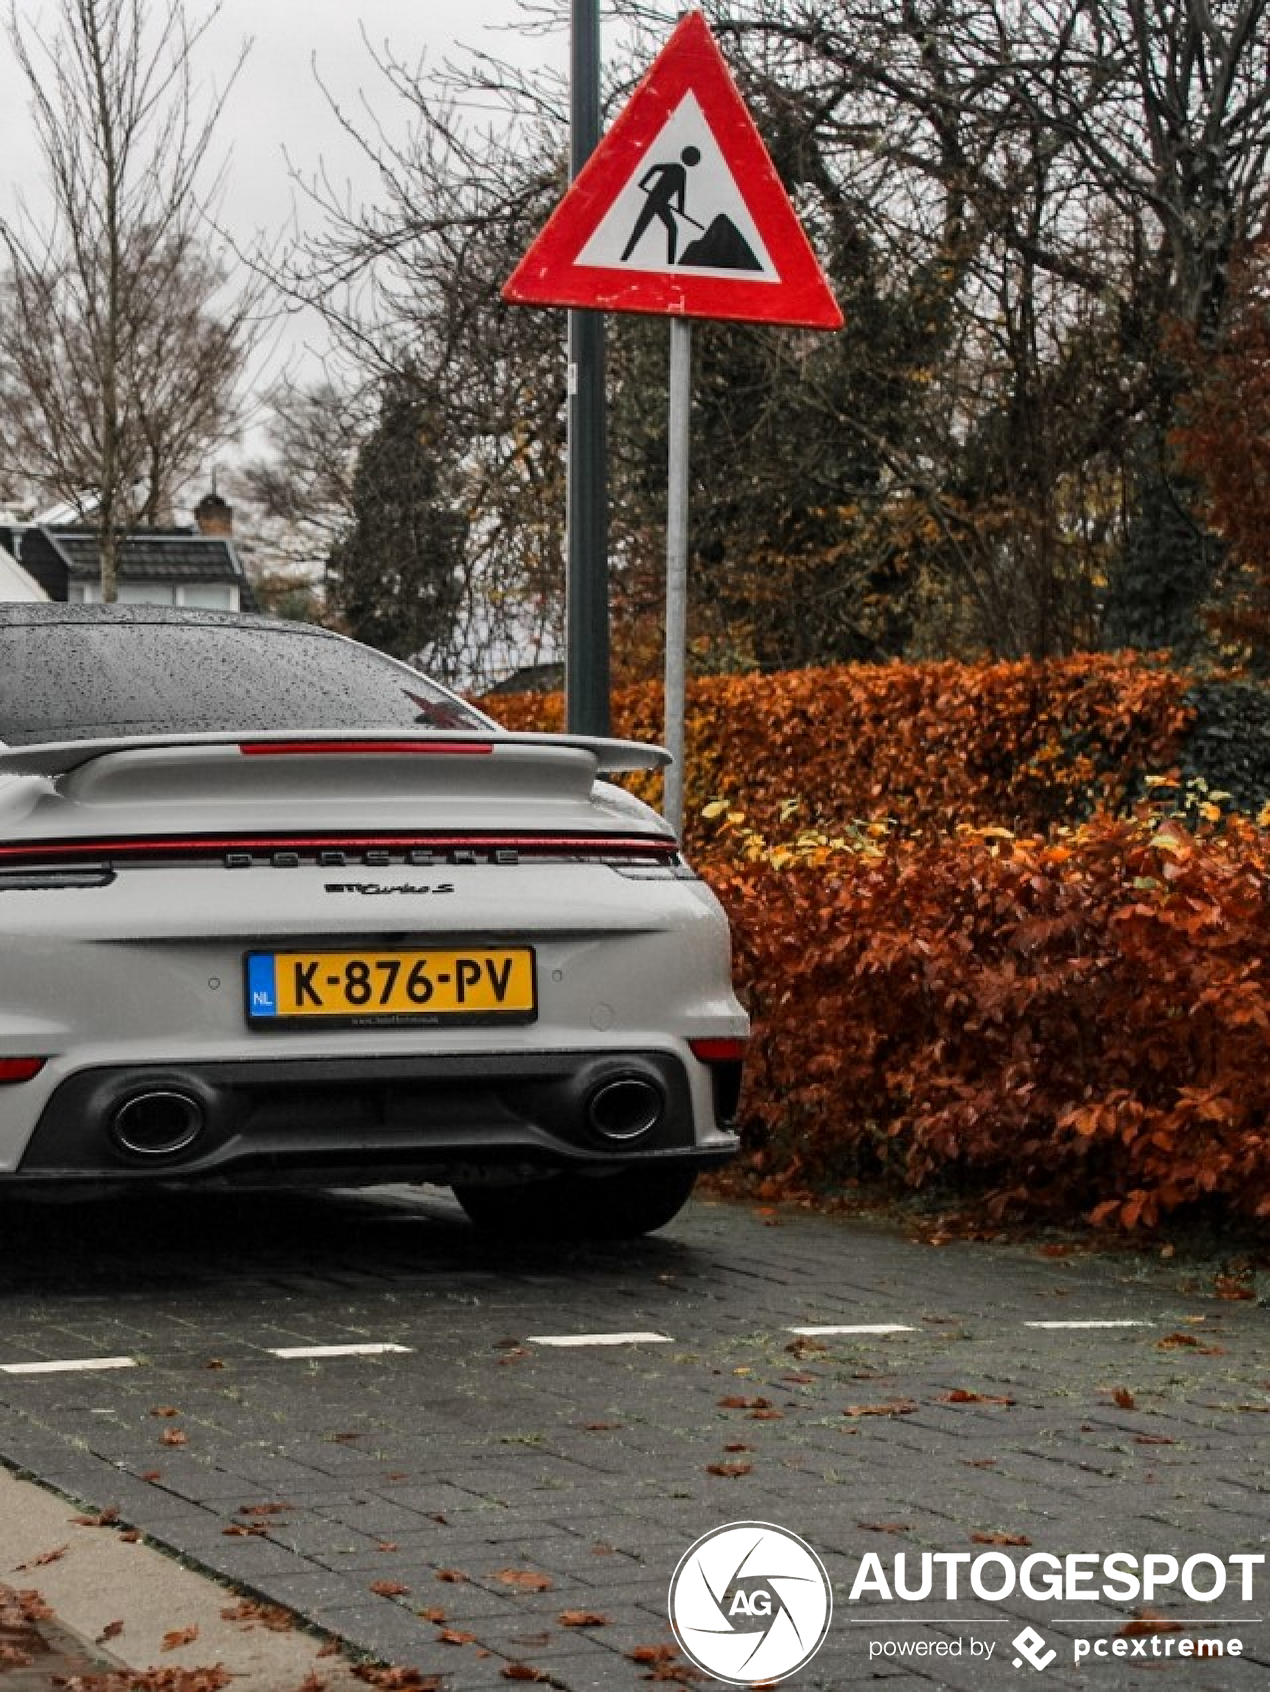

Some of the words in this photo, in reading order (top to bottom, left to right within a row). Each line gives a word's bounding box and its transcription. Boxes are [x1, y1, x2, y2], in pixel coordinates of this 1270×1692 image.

[223, 849, 519, 868] PORSCHE
[294, 957, 513, 1006] K-876-PV
[253, 991, 273, 1005] NL
